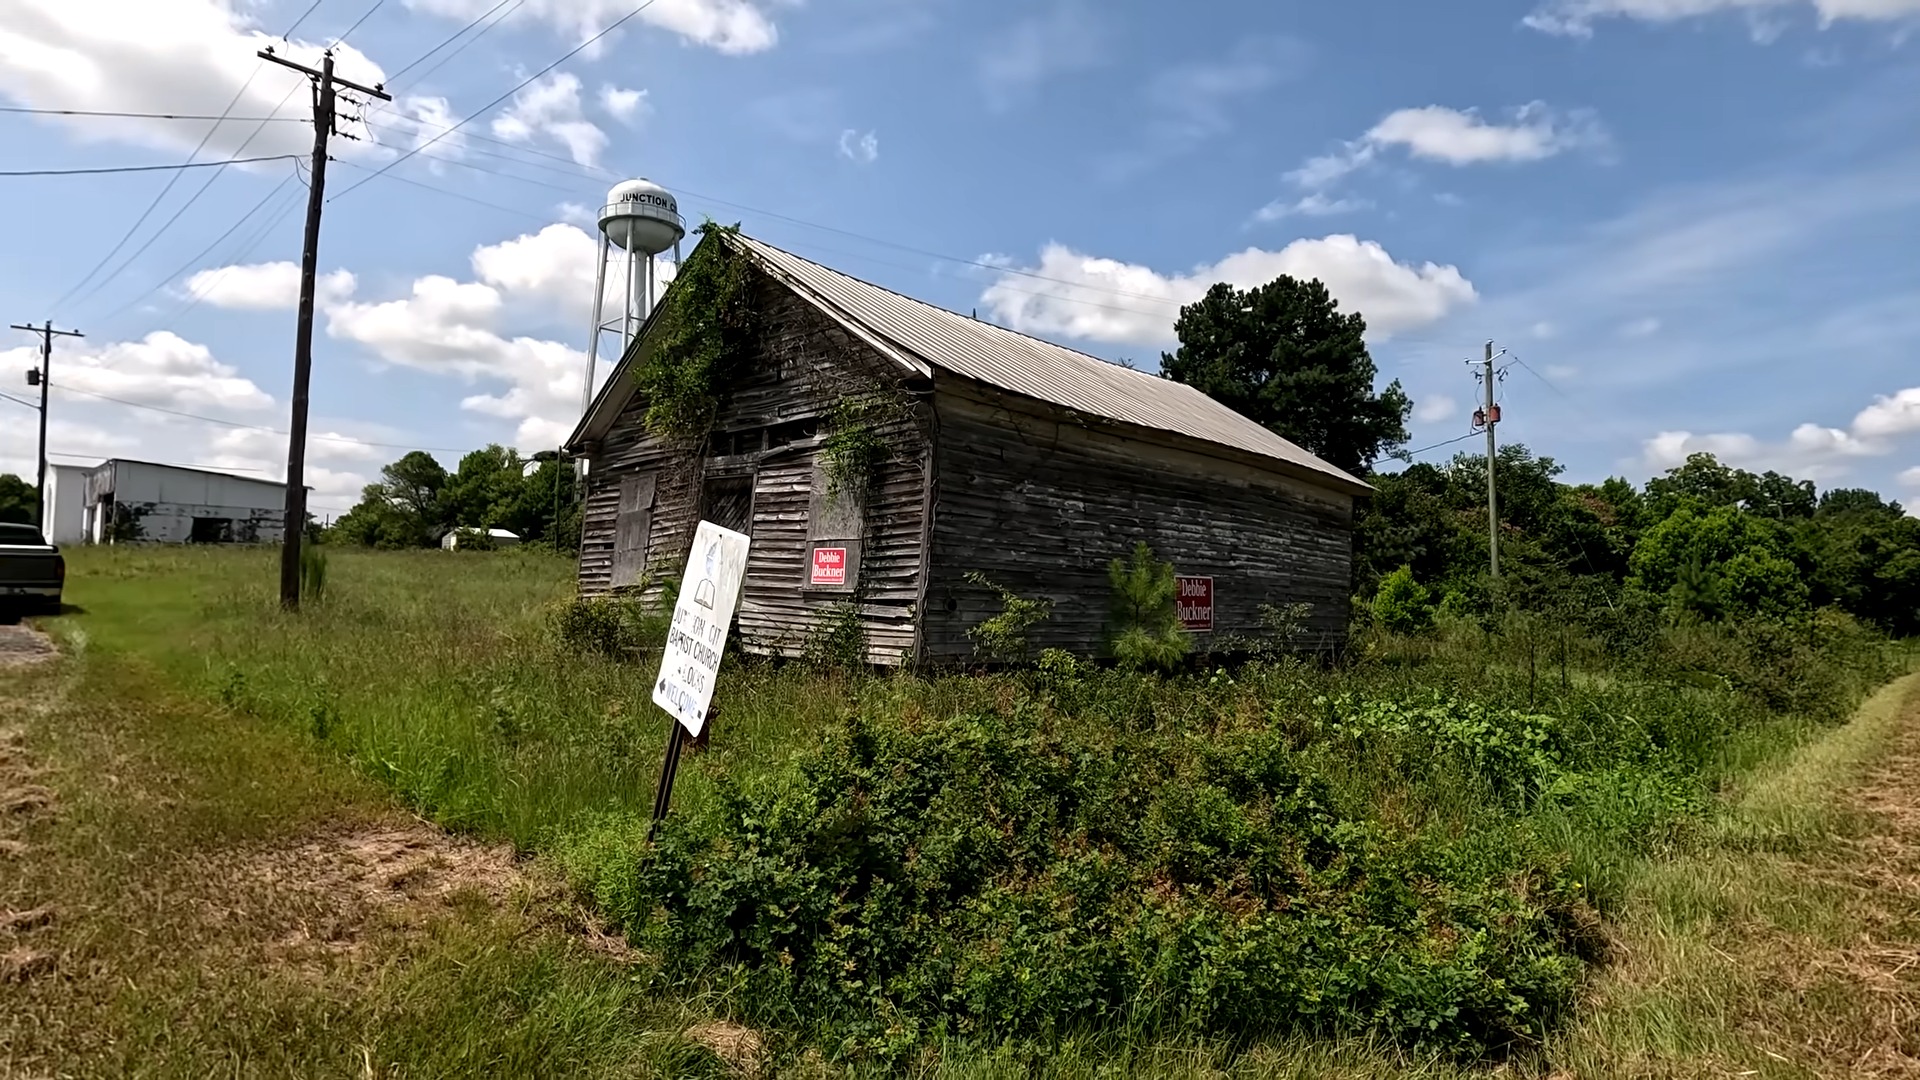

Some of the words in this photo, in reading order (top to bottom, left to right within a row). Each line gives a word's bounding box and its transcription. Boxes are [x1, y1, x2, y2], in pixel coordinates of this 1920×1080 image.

[620, 193, 667, 207] JUNCTION
[818, 551, 840, 563] Debbie
[813, 564, 844, 577] Buckner
[1181, 579, 1207, 597] Debbie
[1177, 600, 1211, 621] Buckner
[669, 627, 694, 655] BAPTIST
[693, 641, 720, 673] CHURCH
[665, 681, 698, 719] WELCOME
